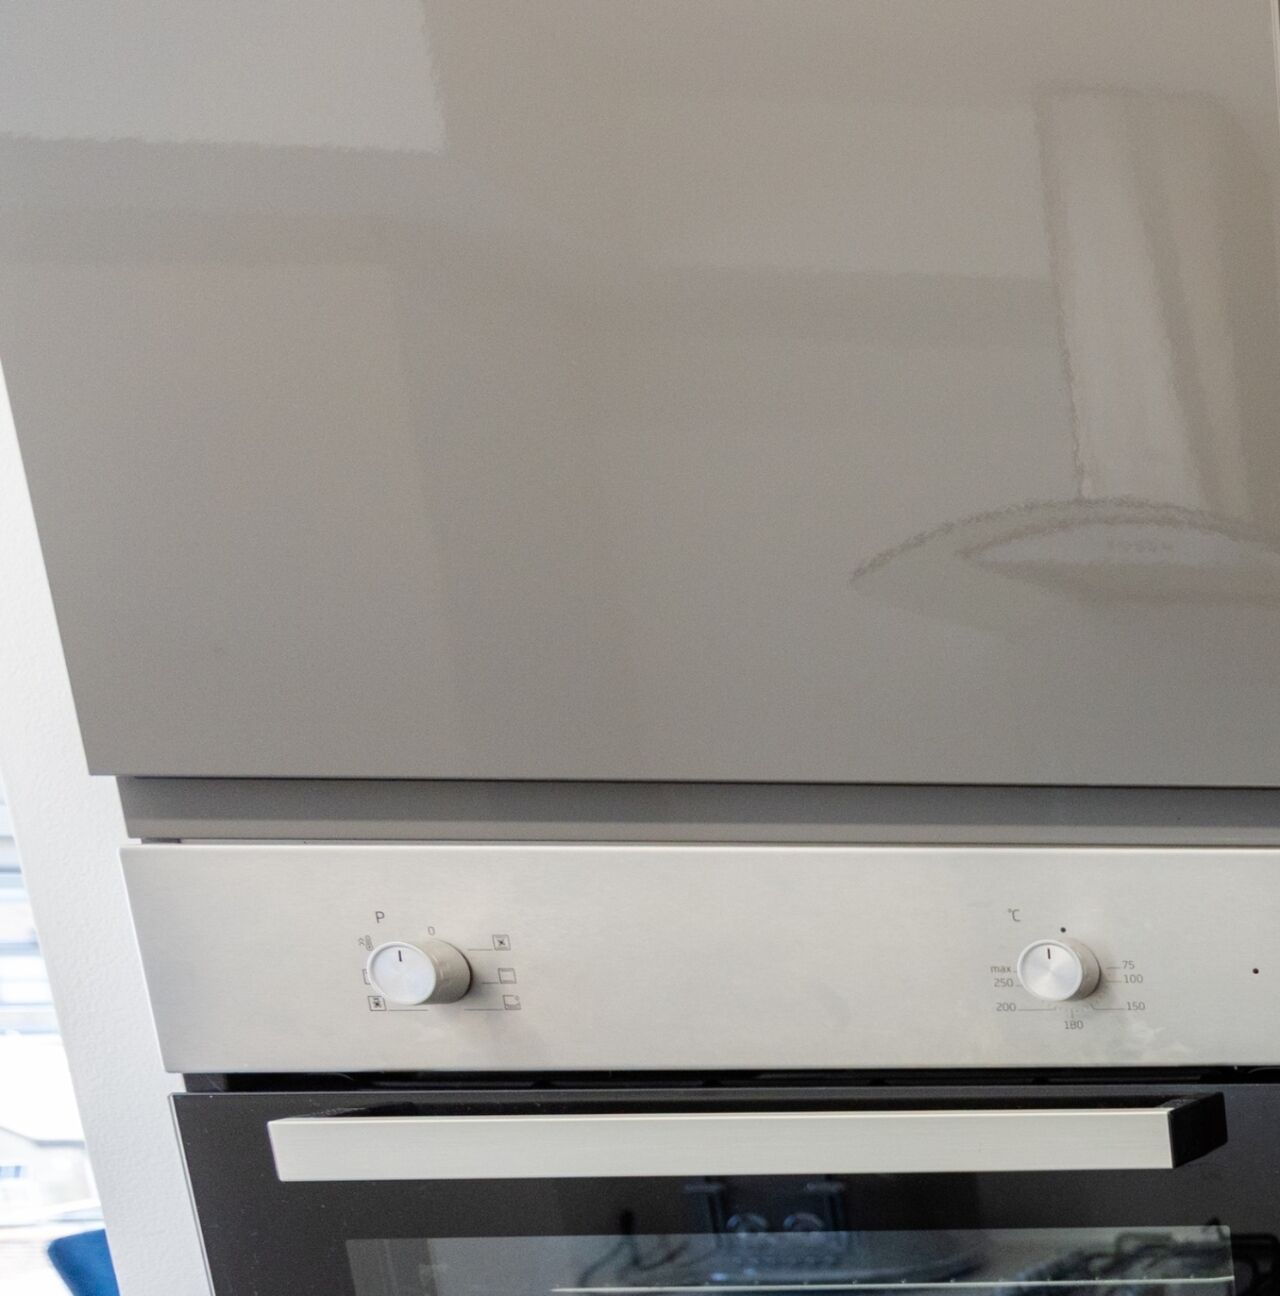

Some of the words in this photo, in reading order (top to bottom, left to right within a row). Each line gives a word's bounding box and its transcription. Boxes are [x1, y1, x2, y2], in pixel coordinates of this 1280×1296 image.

[375, 911, 385, 923] P
[990, 965, 1012, 974] max
[1121, 960, 1135, 970] 75
[994, 978, 1014, 988] 250
[1123, 974, 1144, 984] 100
[996, 1002, 1016, 1012] 200
[1126, 1001, 1145, 1011] 150
[1064, 1020, 1084, 1030] 180
